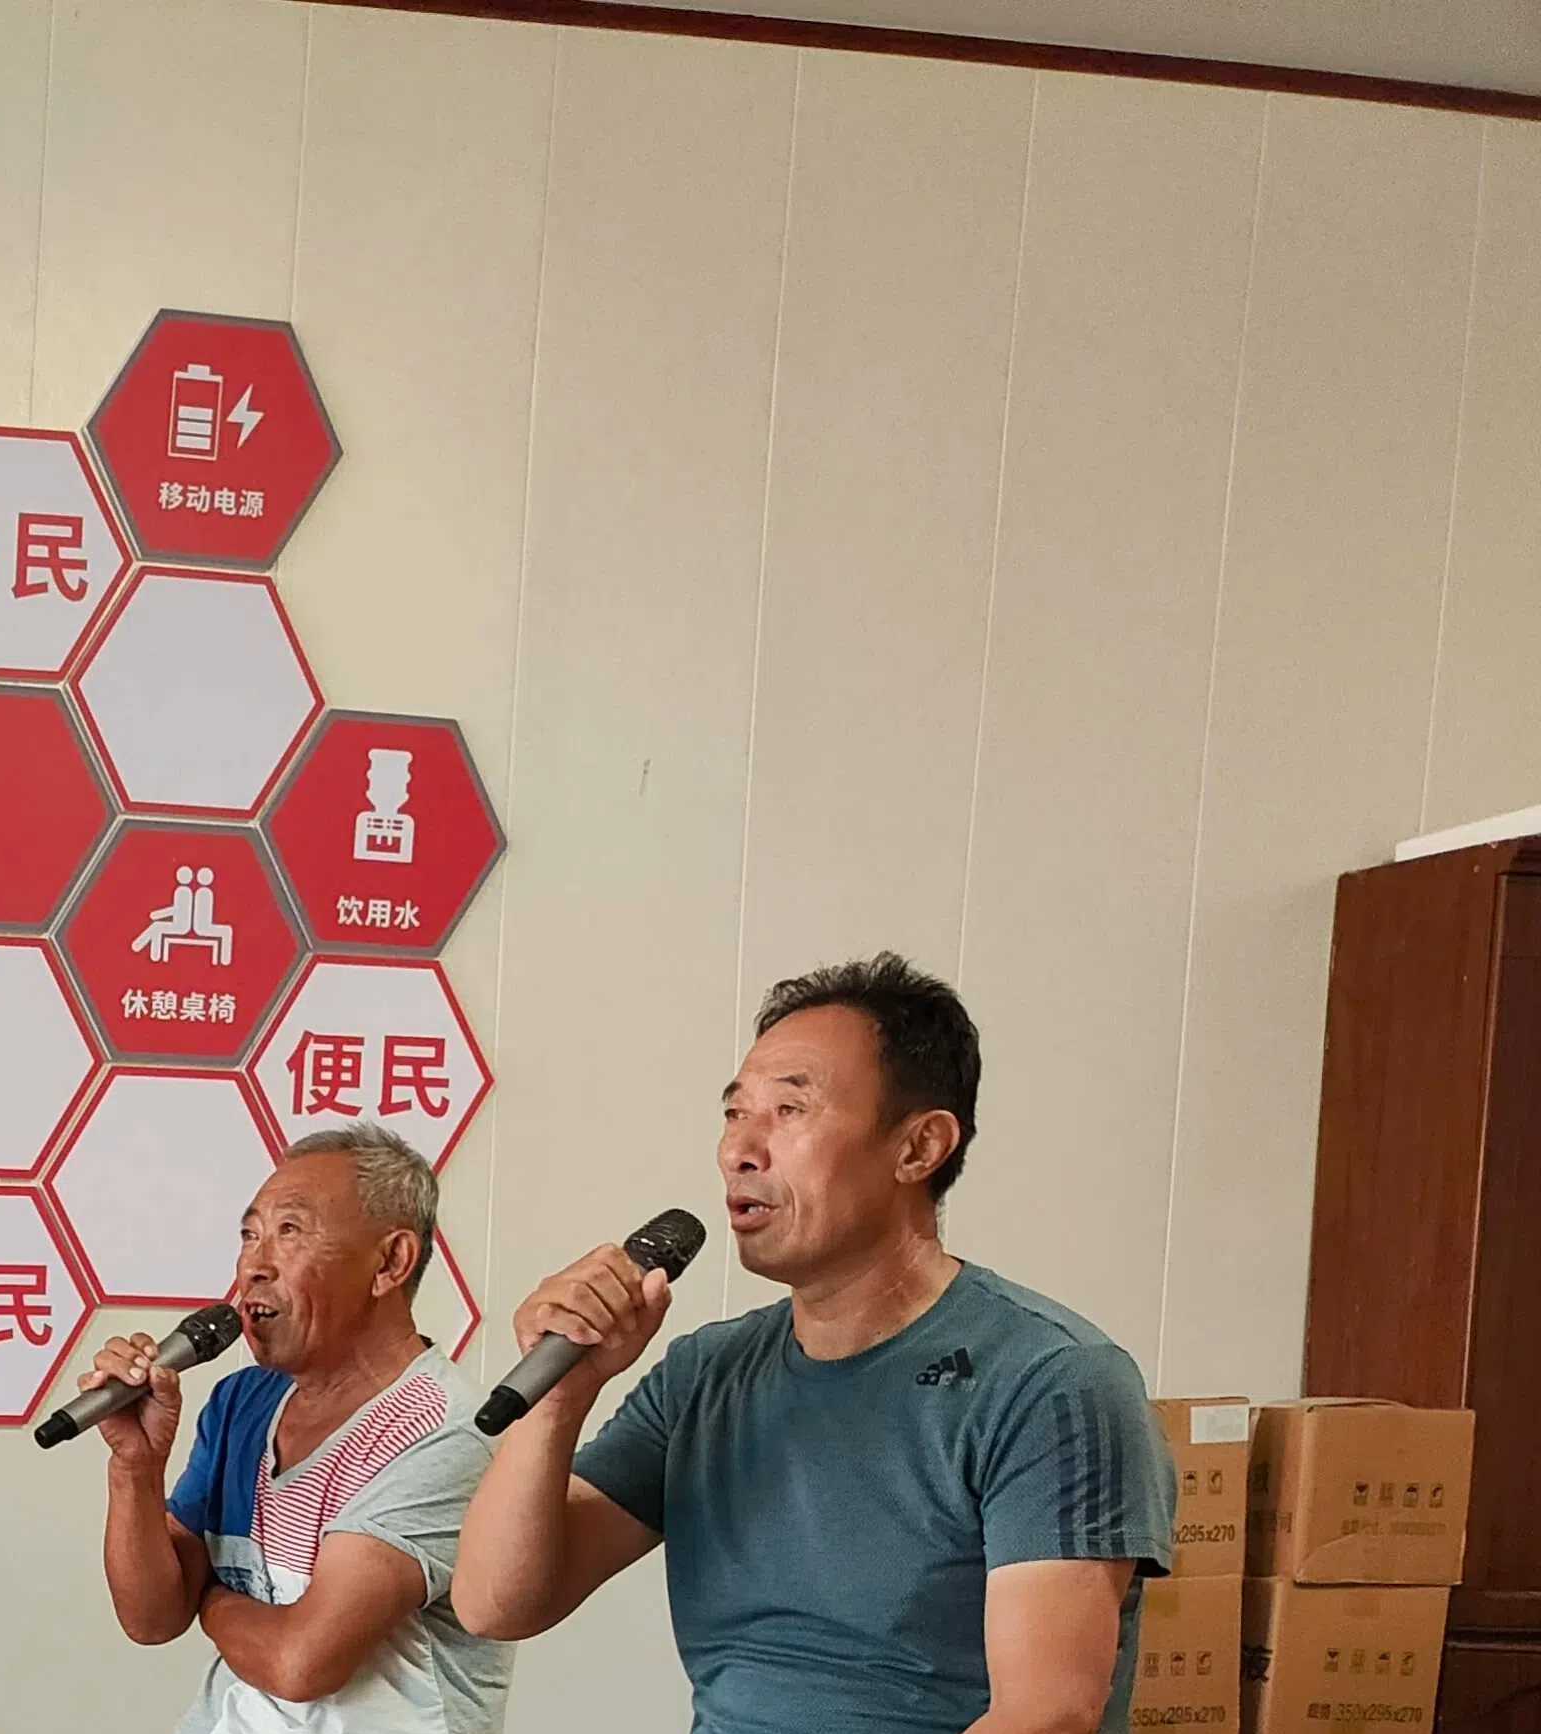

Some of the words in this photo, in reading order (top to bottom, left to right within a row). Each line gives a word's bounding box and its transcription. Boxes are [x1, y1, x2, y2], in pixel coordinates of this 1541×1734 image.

[158, 482, 264, 518] 移动电源
[336, 895, 421, 930] 饮用水
[120, 988, 237, 1024] 休憩桌椅
[284, 1030, 452, 1118] 便民
[1171, 1524, 1236, 1545] x295x270
